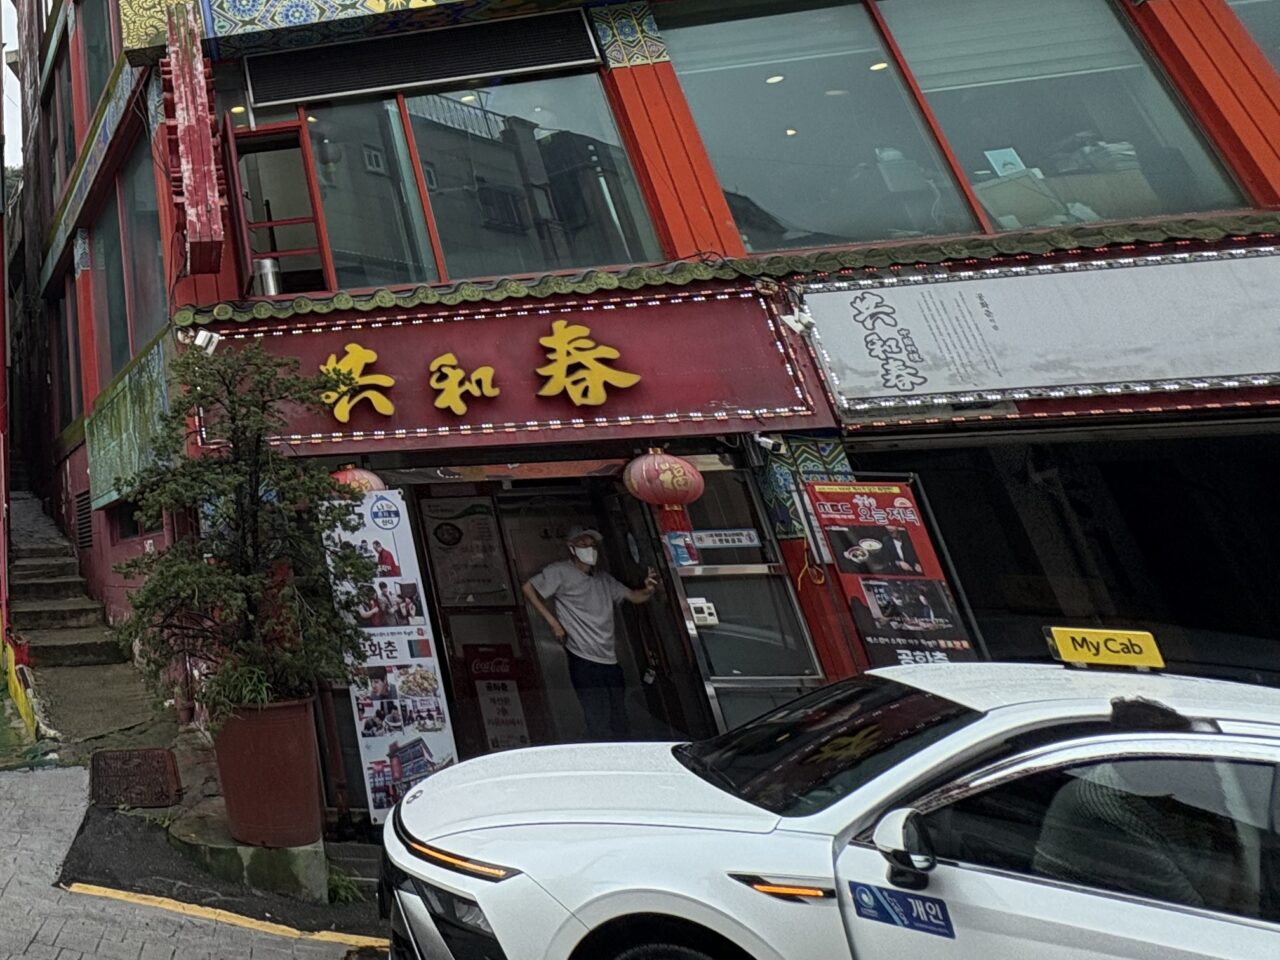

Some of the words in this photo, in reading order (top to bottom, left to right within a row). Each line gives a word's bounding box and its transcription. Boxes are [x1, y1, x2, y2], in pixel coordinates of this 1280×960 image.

[817, 502, 853, 514] MBC
[1070, 636, 1100, 656] My
[1104, 638, 1144, 655] Cab
[907, 897, 946, 926] 개인
